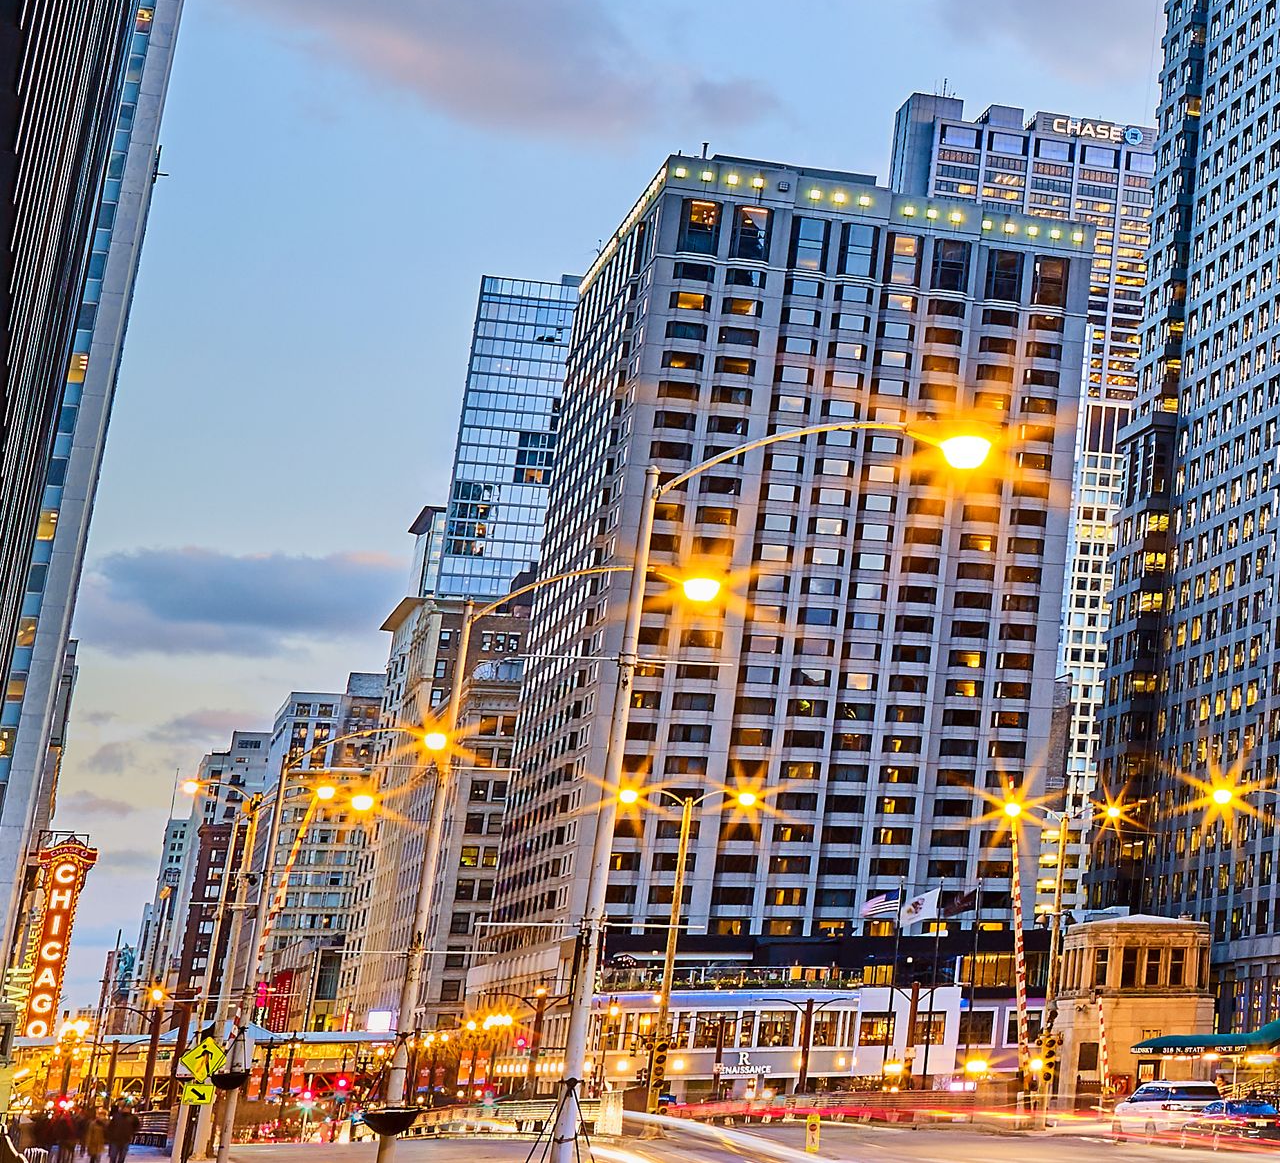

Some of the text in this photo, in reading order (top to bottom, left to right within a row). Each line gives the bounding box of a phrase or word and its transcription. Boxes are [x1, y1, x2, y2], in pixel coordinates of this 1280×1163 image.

[1053, 117, 1125, 141] CHASE
[51, 848, 80, 857] CHASE
[27, 863, 76, 1038] CHICAGO
[1184, 1046, 1205, 1054] STATE
[720, 1065, 772, 1075] ENAISSANCE
